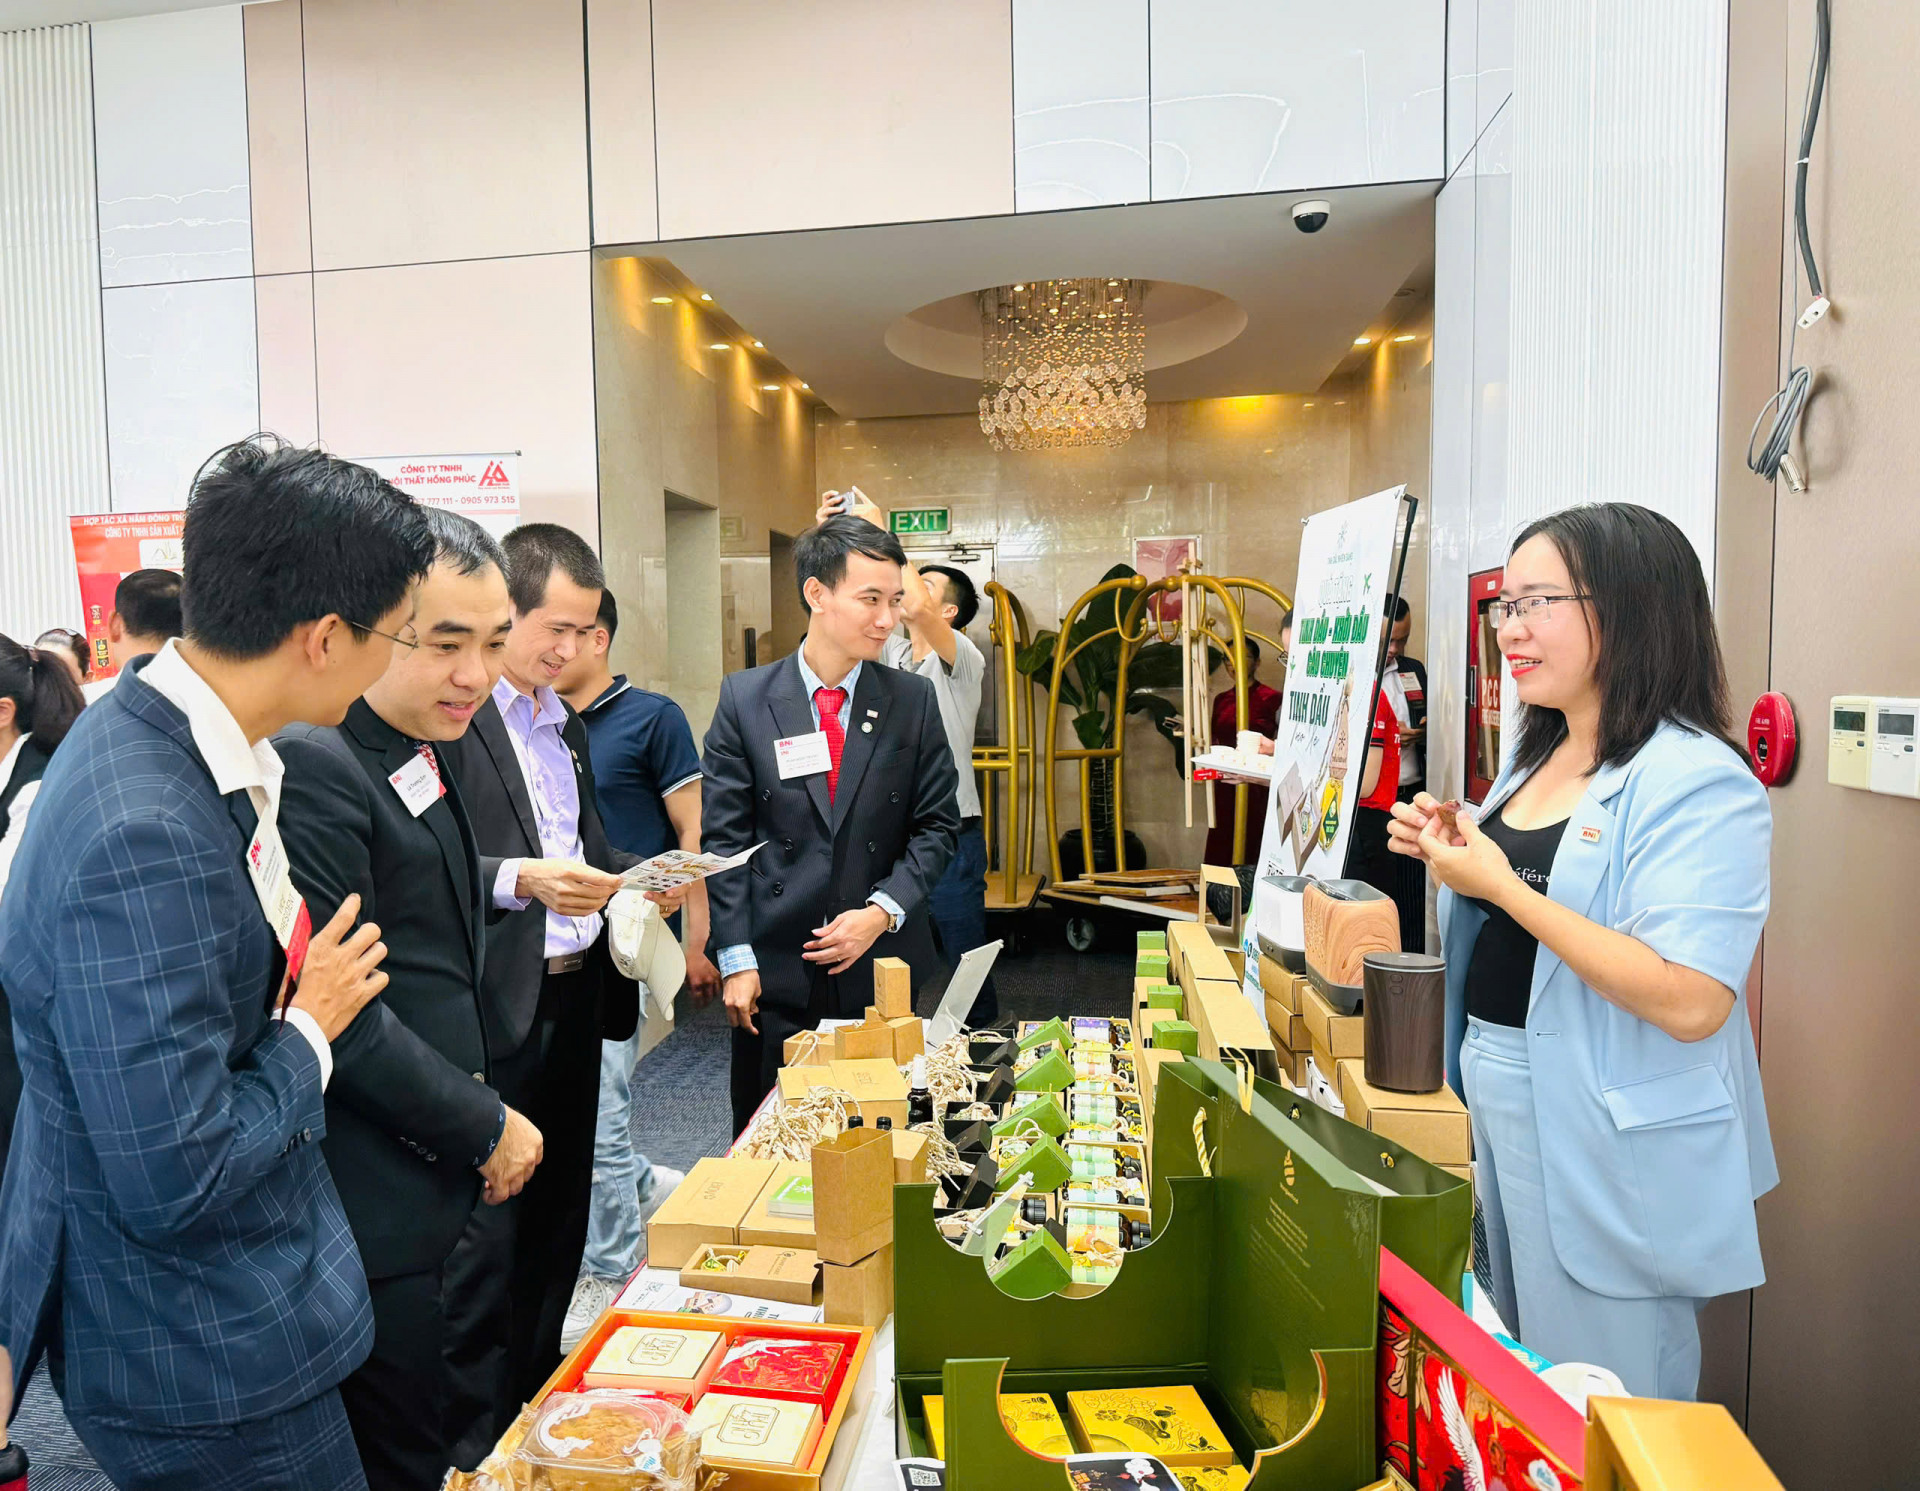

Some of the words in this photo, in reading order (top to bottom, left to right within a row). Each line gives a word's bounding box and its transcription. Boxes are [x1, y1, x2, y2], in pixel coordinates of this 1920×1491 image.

[400, 464, 425, 474] CÔNG
[427, 465, 437, 473] TY
[439, 464, 462, 473] TNHH
[453, 472, 477, 483] PHÚC
[461, 496, 481, 505] 0905
[484, 495, 499, 504] 973
[501, 495, 516, 504] 515
[100, 515, 114, 524] TÁC
[895, 511, 942, 531] EXIT
[105, 526, 121, 539] CÔNG
[122, 527, 130, 537] TY
[132, 526, 149, 537] TNHH
[1289, 691, 1310, 723] TINH
